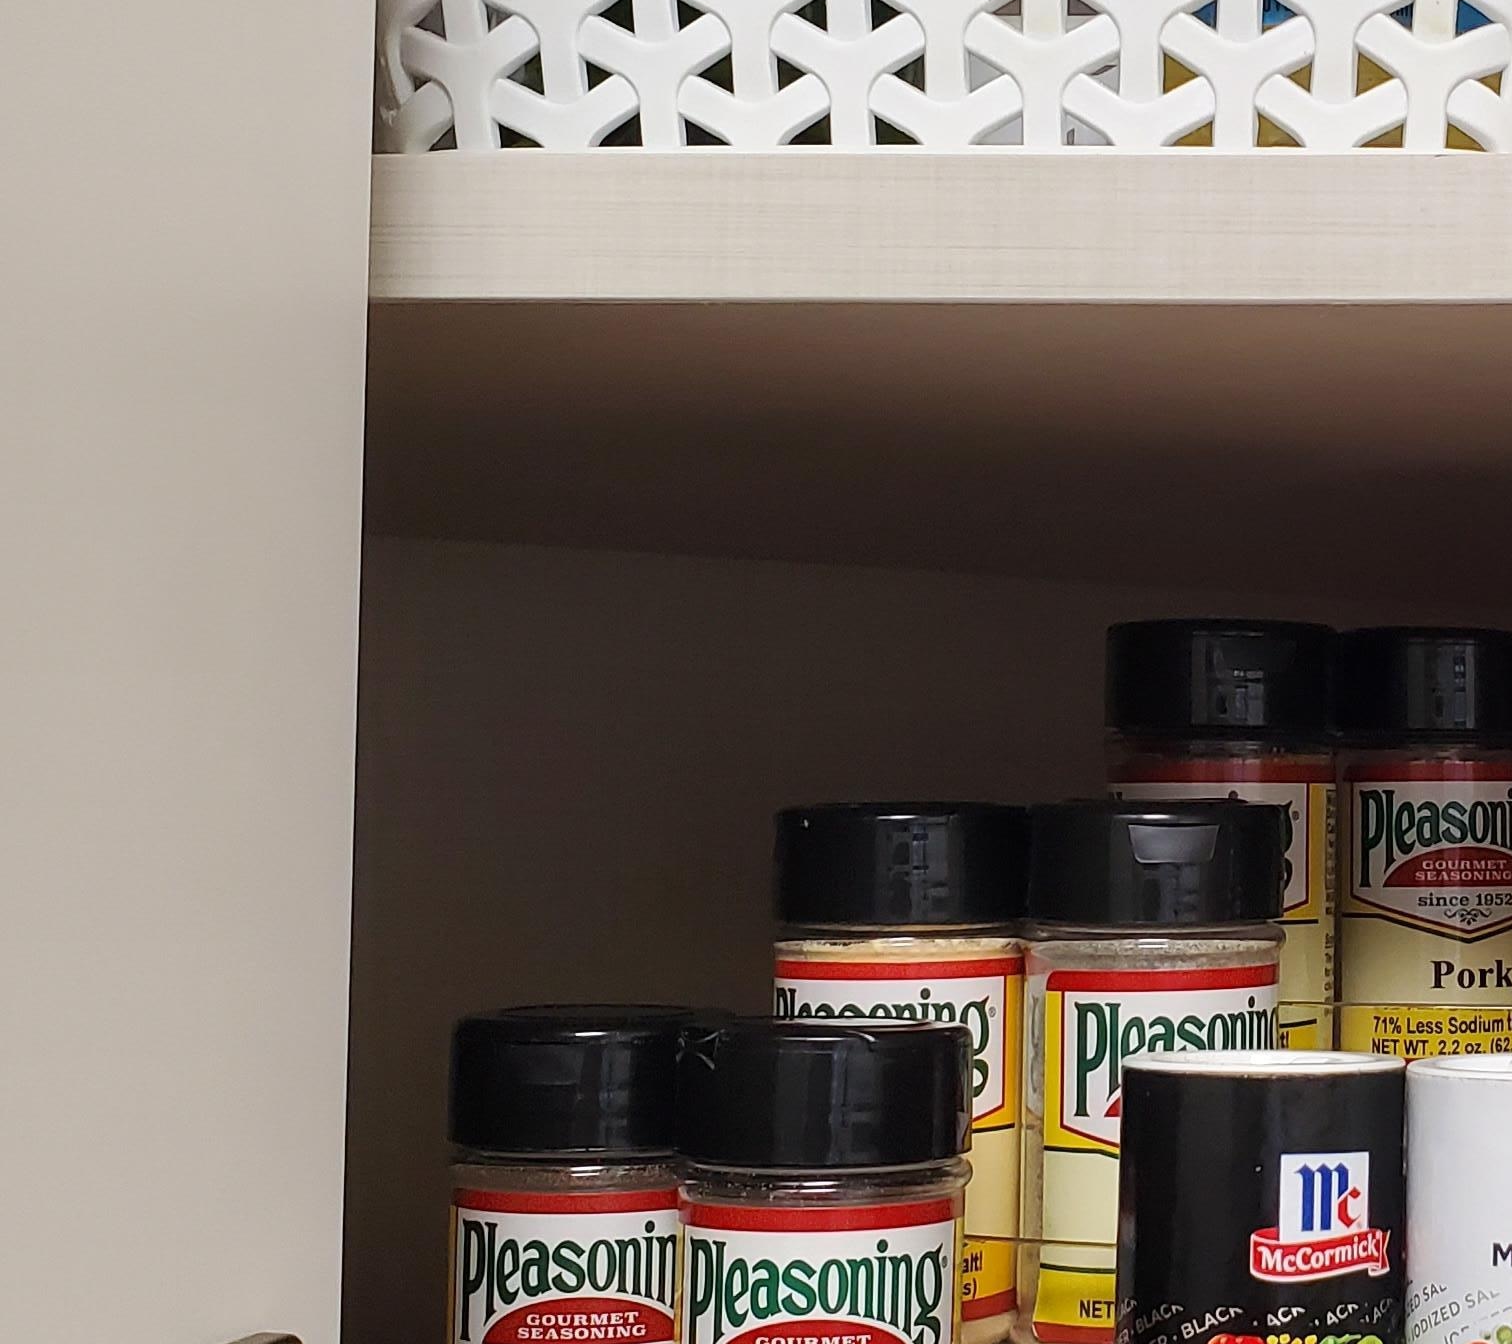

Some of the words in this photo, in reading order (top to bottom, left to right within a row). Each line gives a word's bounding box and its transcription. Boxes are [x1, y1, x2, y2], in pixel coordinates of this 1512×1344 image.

[1421, 859, 1507, 870] GOURMET
[1414, 869, 1512, 881] SEASONING
[1417, 893, 1470, 907] since
[1373, 1015, 1402, 1035] 71%
[1406, 1016, 1443, 1035] Less
[1447, 1016, 1504, 1035] Sodium
[1371, 1038, 1400, 1055] NET
[1404, 1039, 1435, 1056] WT.
[1438, 1039, 1460, 1056] 2.2
[1464, 1042, 1487, 1056] oz.
[1256, 1232, 1380, 1273] McCormick
[461, 1218, 677, 1342] Pleasonin
[525, 1312, 640, 1328] GOURMET
[1411, 1301, 1461, 1342] IODIZED
[516, 1324, 647, 1341] SEASONING
